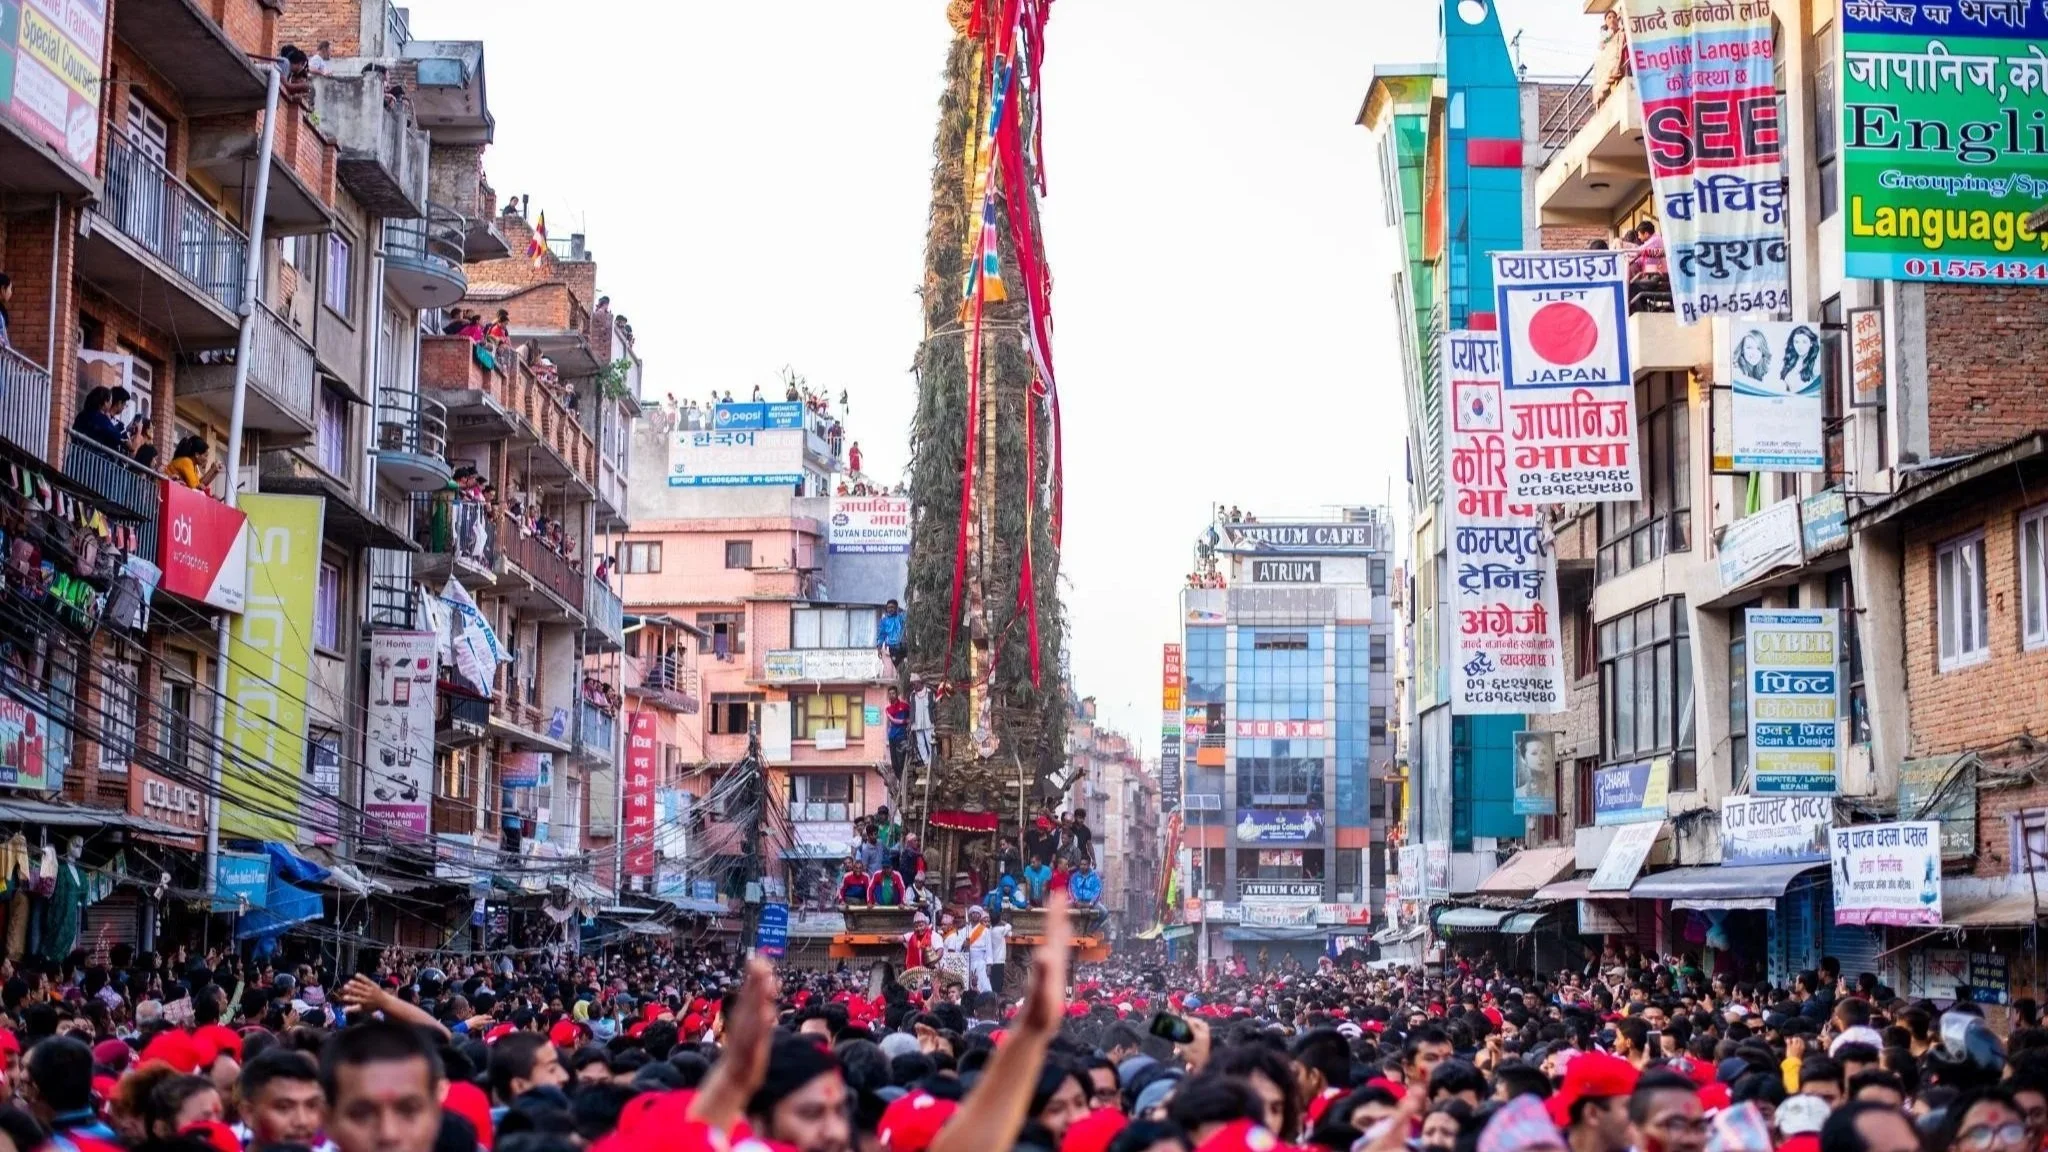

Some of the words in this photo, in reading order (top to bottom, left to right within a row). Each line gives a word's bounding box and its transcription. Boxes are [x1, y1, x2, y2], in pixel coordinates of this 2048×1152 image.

[1923, 5, 1952, 24] मा
[23, 10, 61, 63] Special
[61, 43, 98, 97] Courses
[1648, 96, 1779, 170] SEE
[1846, 103, 2048, 164] Engli
[1498, 254, 1618, 282] प्याराडाइज
[1532, 291, 1588, 302] JLPT
[1526, 367, 1606, 383] JAPAN
[732, 411, 762, 422] pepsi
[1510, 388, 1628, 441] जापानिज
[693, 432, 754, 447] 한국어
[1515, 443, 1630, 469] भाषा
[173, 514, 192, 547] obi
[833, 529, 860, 538] SUYAN
[862, 529, 908, 538] EDUCATION
[1233, 528, 1308, 545] ATRIUM
[1314, 527, 1365, 544] CAFE
[1259, 563, 1315, 581] ATRIUM
[1459, 602, 1548, 637] अंग्रेजी
[386, 640, 412, 648] Home
[1756, 632, 1831, 653] CYBER
[1761, 671, 1830, 692] प्रिन्ट
[1800, 722, 1833, 735] प्रिन्ट
[1757, 736, 1783, 745] Scan
[1787, 736, 1794, 745] &
[1798, 736, 1834, 748] Design
[1605, 770, 1630, 790] CHARAK
[1726, 803, 1745, 829] राज
[1852, 830, 1874, 849] पाटन
[1903, 827, 1928, 847] पसल
[1245, 885, 1287, 895] ATRIUM
[1291, 885, 1317, 895] CAFE
